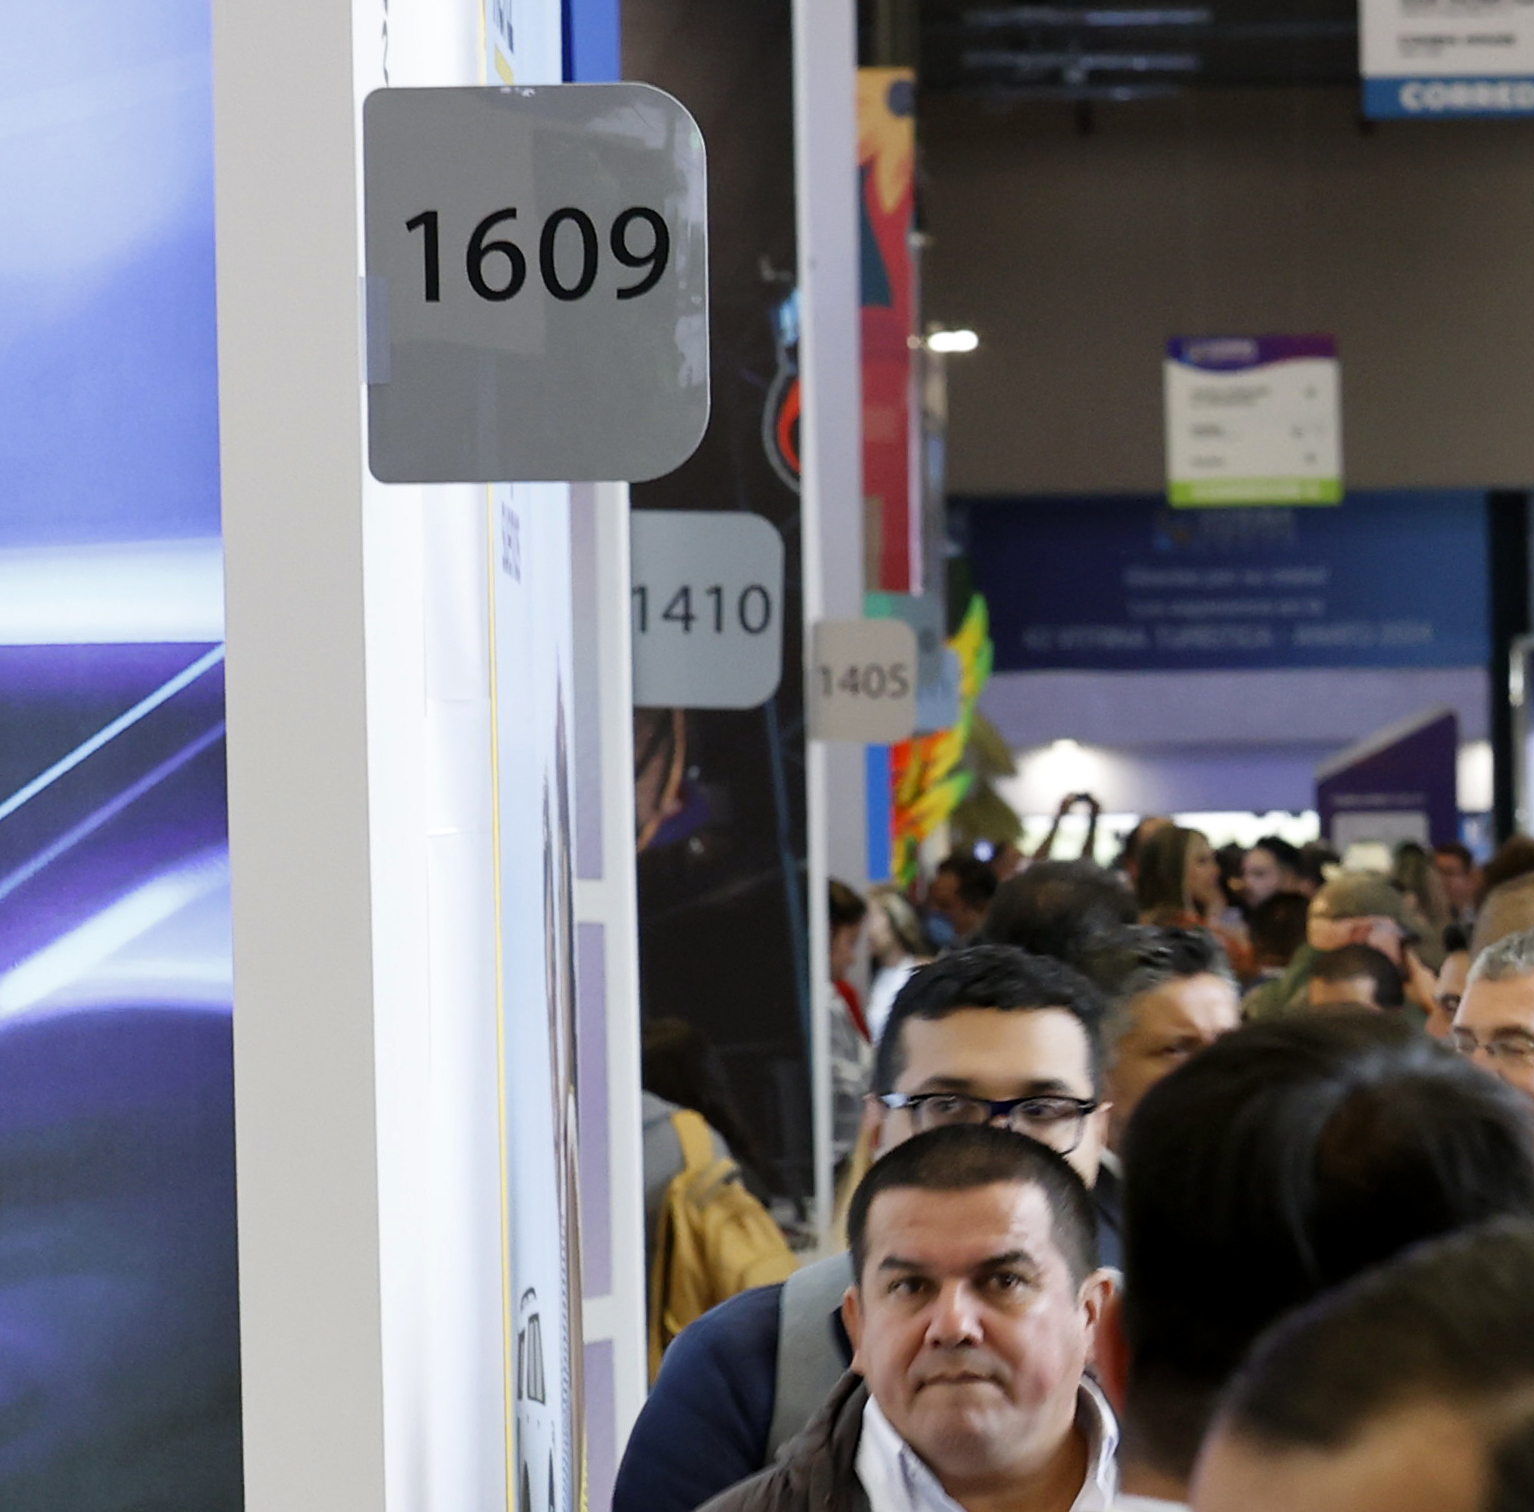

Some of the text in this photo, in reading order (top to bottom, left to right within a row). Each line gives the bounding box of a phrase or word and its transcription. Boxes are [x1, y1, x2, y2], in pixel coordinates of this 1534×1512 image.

[405, 206, 670, 303] 1609
[631, 584, 772, 635] 1410
[817, 663, 910, 699] 1405
